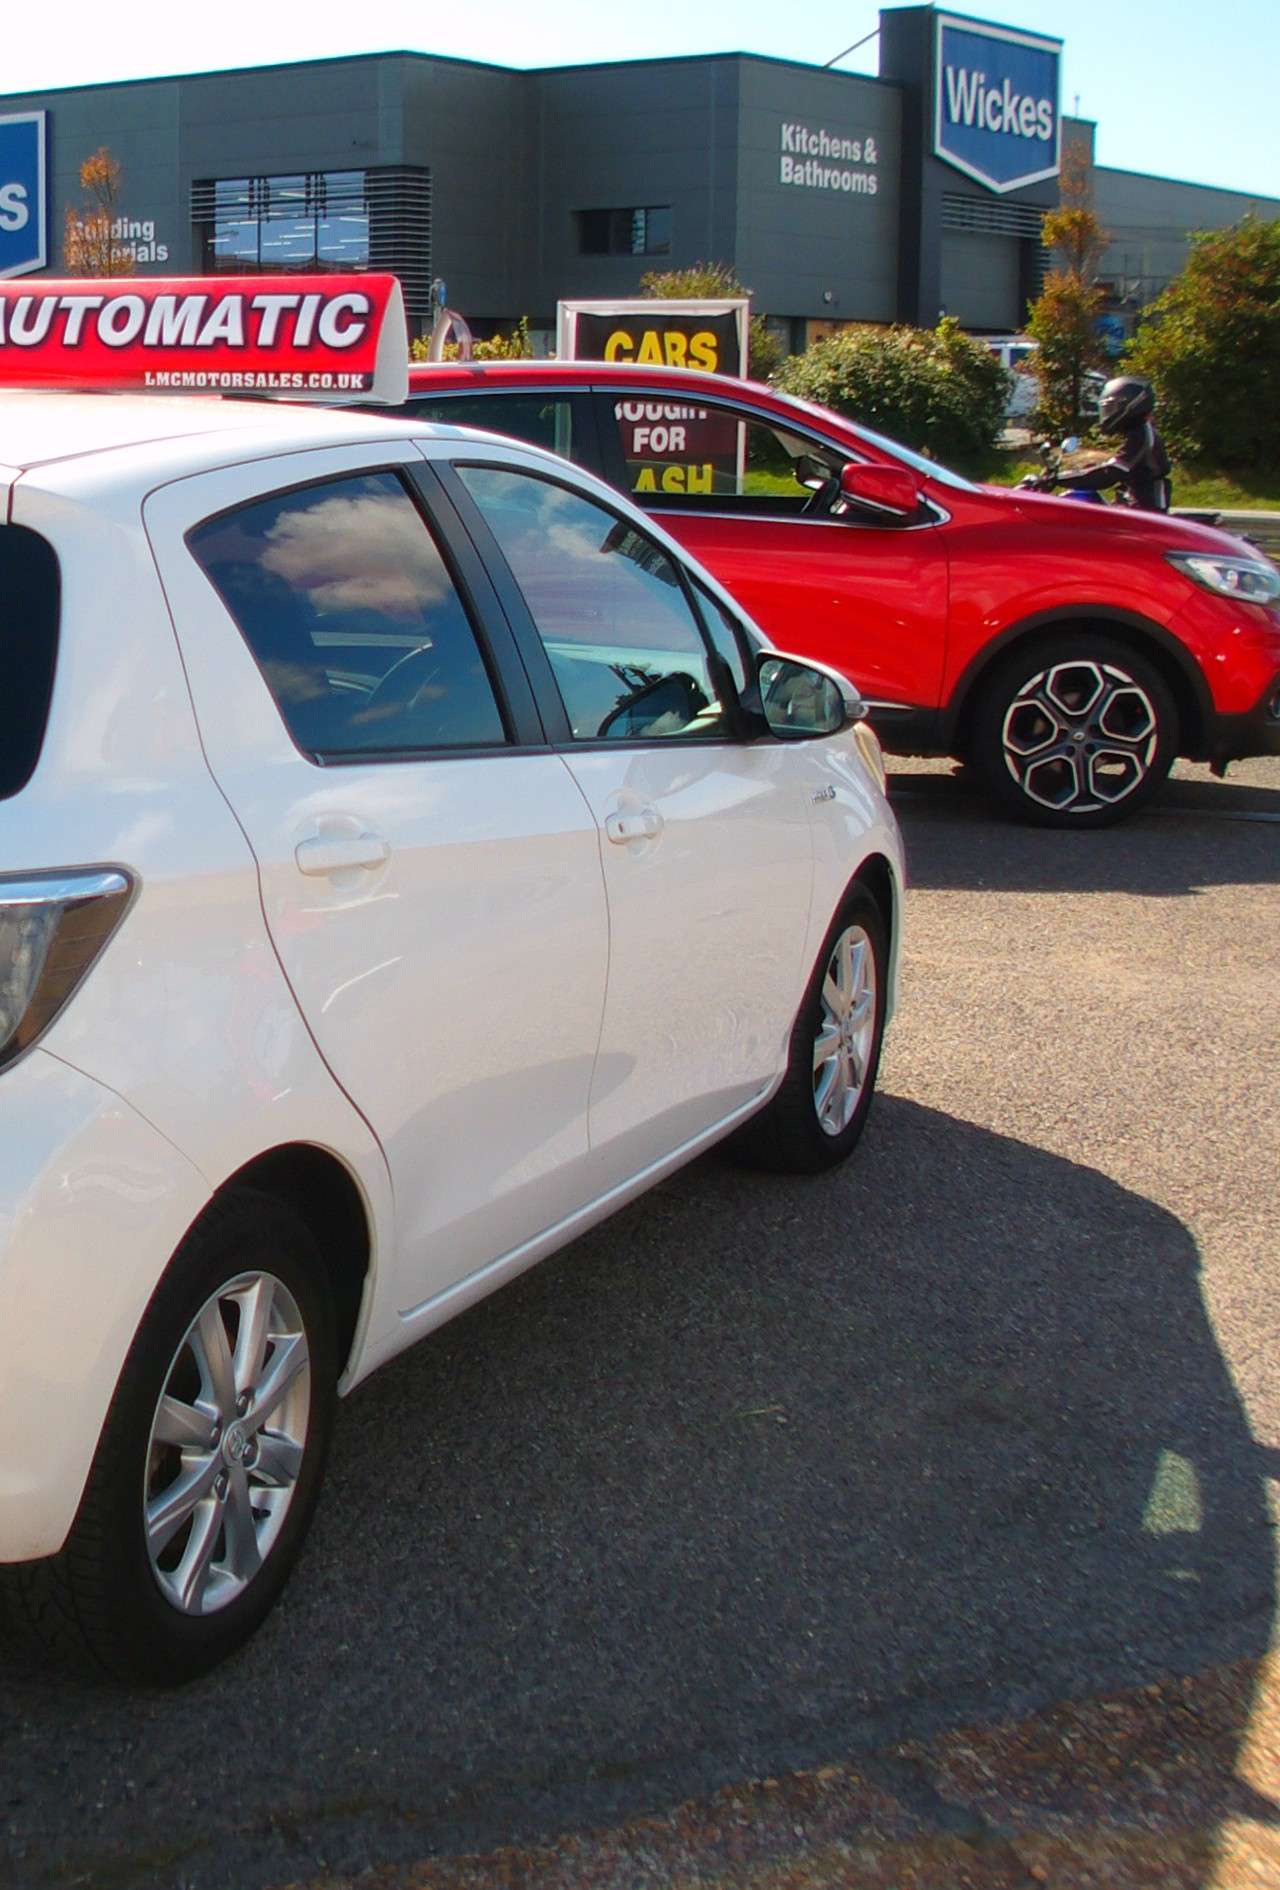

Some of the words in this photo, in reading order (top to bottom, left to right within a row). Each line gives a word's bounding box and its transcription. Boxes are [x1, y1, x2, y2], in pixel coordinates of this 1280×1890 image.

[946, 65, 1052, 140] Wickes
[781, 123, 861, 161] Kitchens
[863, 137, 877, 164] &
[780, 156, 878, 195] Bathrooms
[604, 331, 718, 373] CARS
[144, 371, 364, 390] LMCMOTORSALES.CO.UK
[632, 425, 686, 452] FOR
[634, 464, 713, 493] ASH
